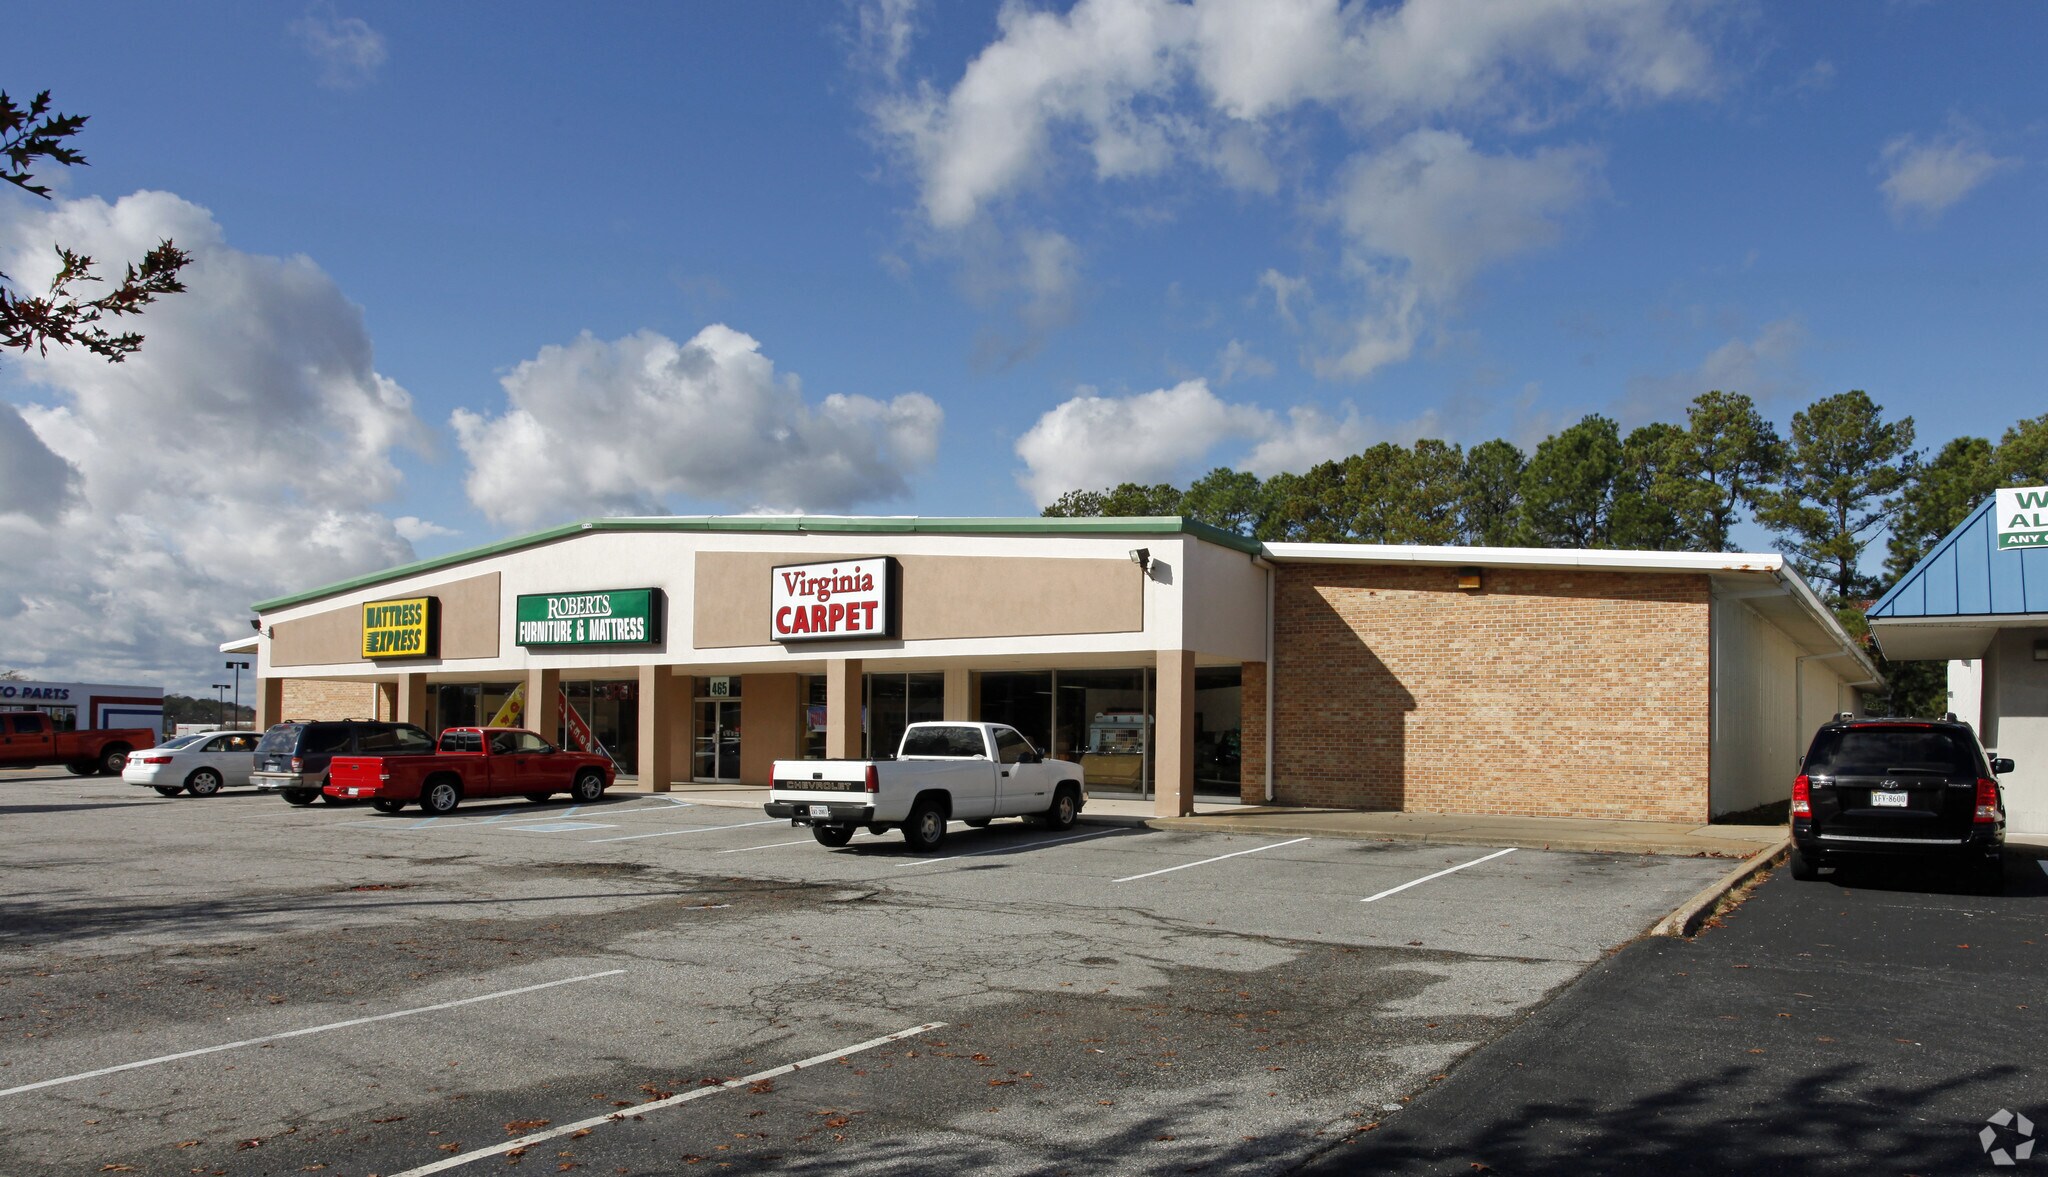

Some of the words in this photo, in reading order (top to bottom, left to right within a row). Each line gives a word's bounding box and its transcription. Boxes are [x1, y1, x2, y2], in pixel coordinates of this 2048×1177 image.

[2007, 535, 2040, 543] ANY
[781, 566, 874, 602] Virginia
[366, 603, 422, 628] MATTRESS
[547, 595, 612, 619] ROBERTS
[776, 600, 878, 634] CARPET
[365, 628, 422, 653] EXPRESS
[519, 620, 572, 643] FURNITURE
[576, 619, 585, 641] &
[589, 617, 645, 641] MATTRESS
[21, 686, 70, 700] PARTS
[712, 682, 727, 695] 465
[786, 781, 852, 790] CHEVROLET
